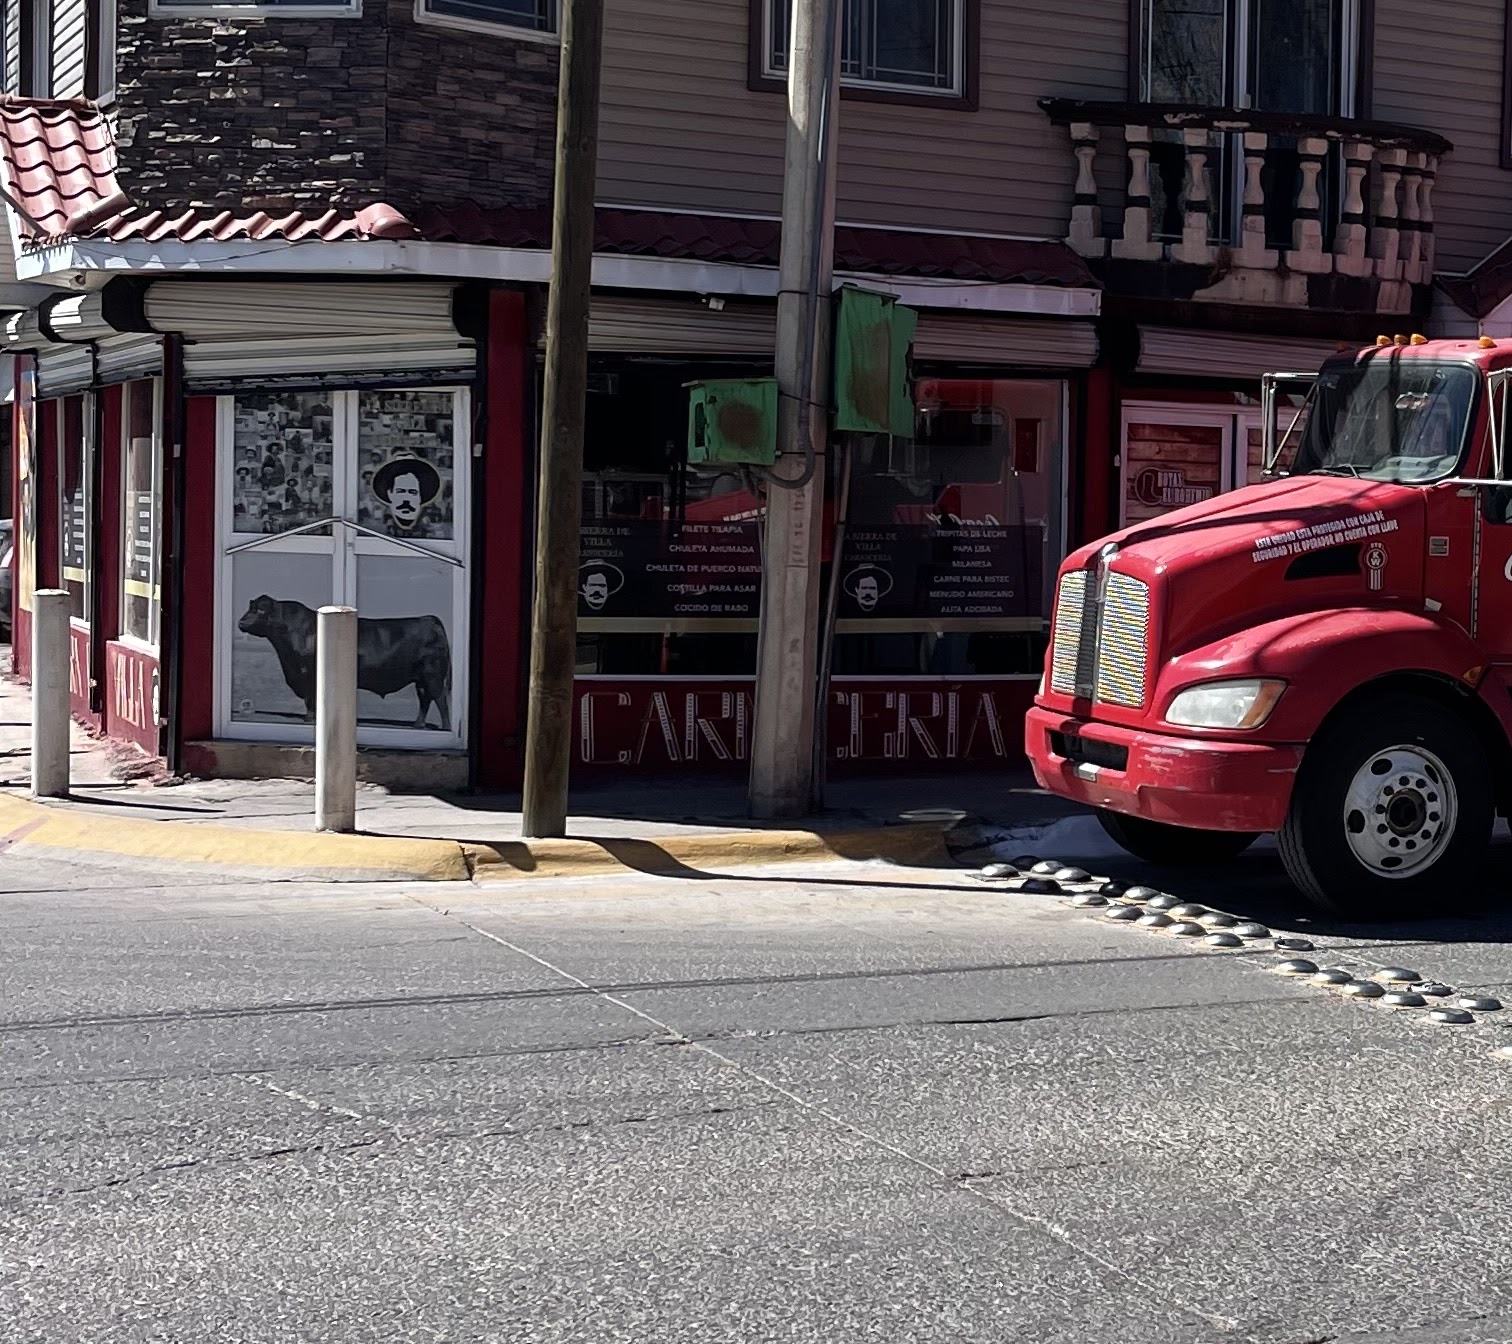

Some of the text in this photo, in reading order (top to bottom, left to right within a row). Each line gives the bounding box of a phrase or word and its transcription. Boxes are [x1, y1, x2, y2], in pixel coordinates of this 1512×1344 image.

[1374, 510, 1385, 521] DE
[687, 564, 699, 572] DE
[708, 584, 732, 593] PARA
[733, 585, 757, 593] ASAR
[710, 604, 723, 612] DE
